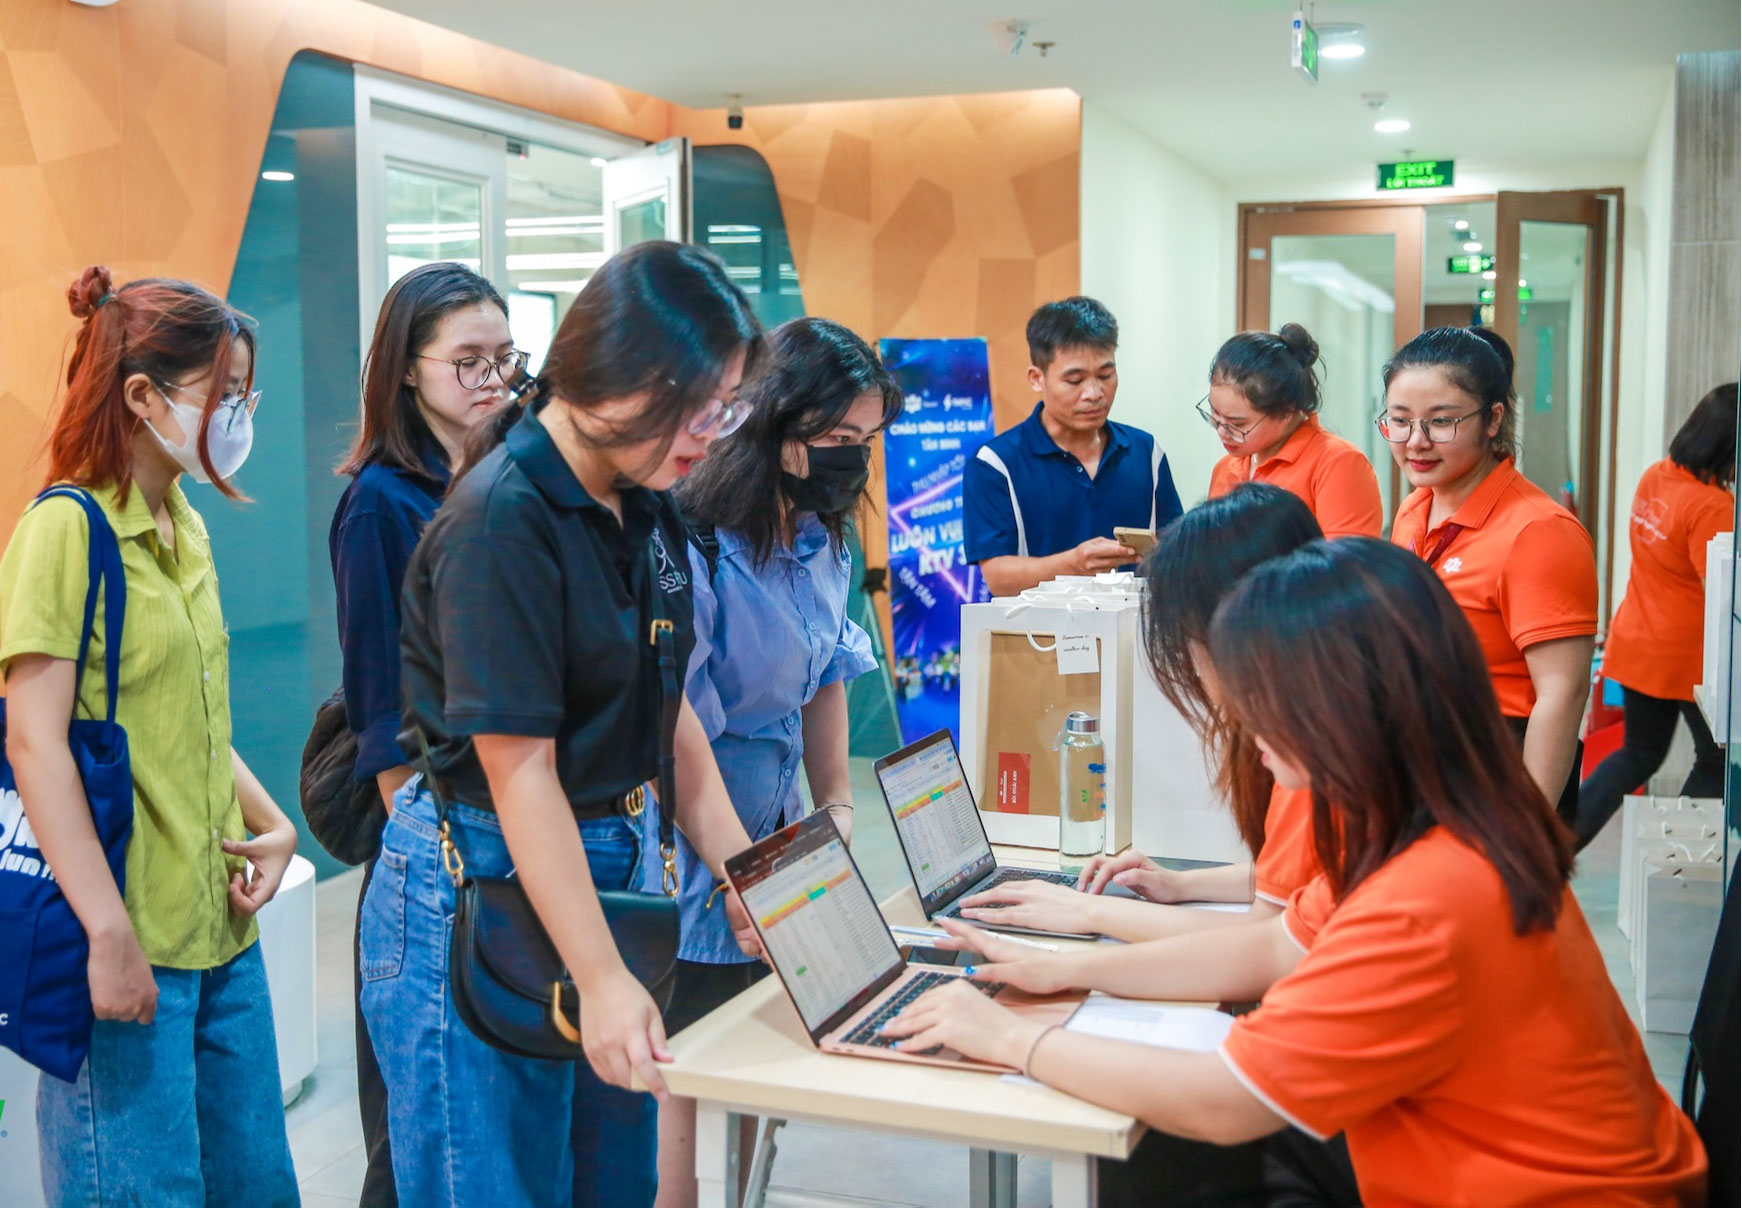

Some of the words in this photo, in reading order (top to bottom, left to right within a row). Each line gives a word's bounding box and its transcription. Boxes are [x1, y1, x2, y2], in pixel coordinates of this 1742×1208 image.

[1395, 161, 1437, 177] EXIT
[891, 524, 936, 553] LUÔN
[918, 547, 955, 576] KTV
